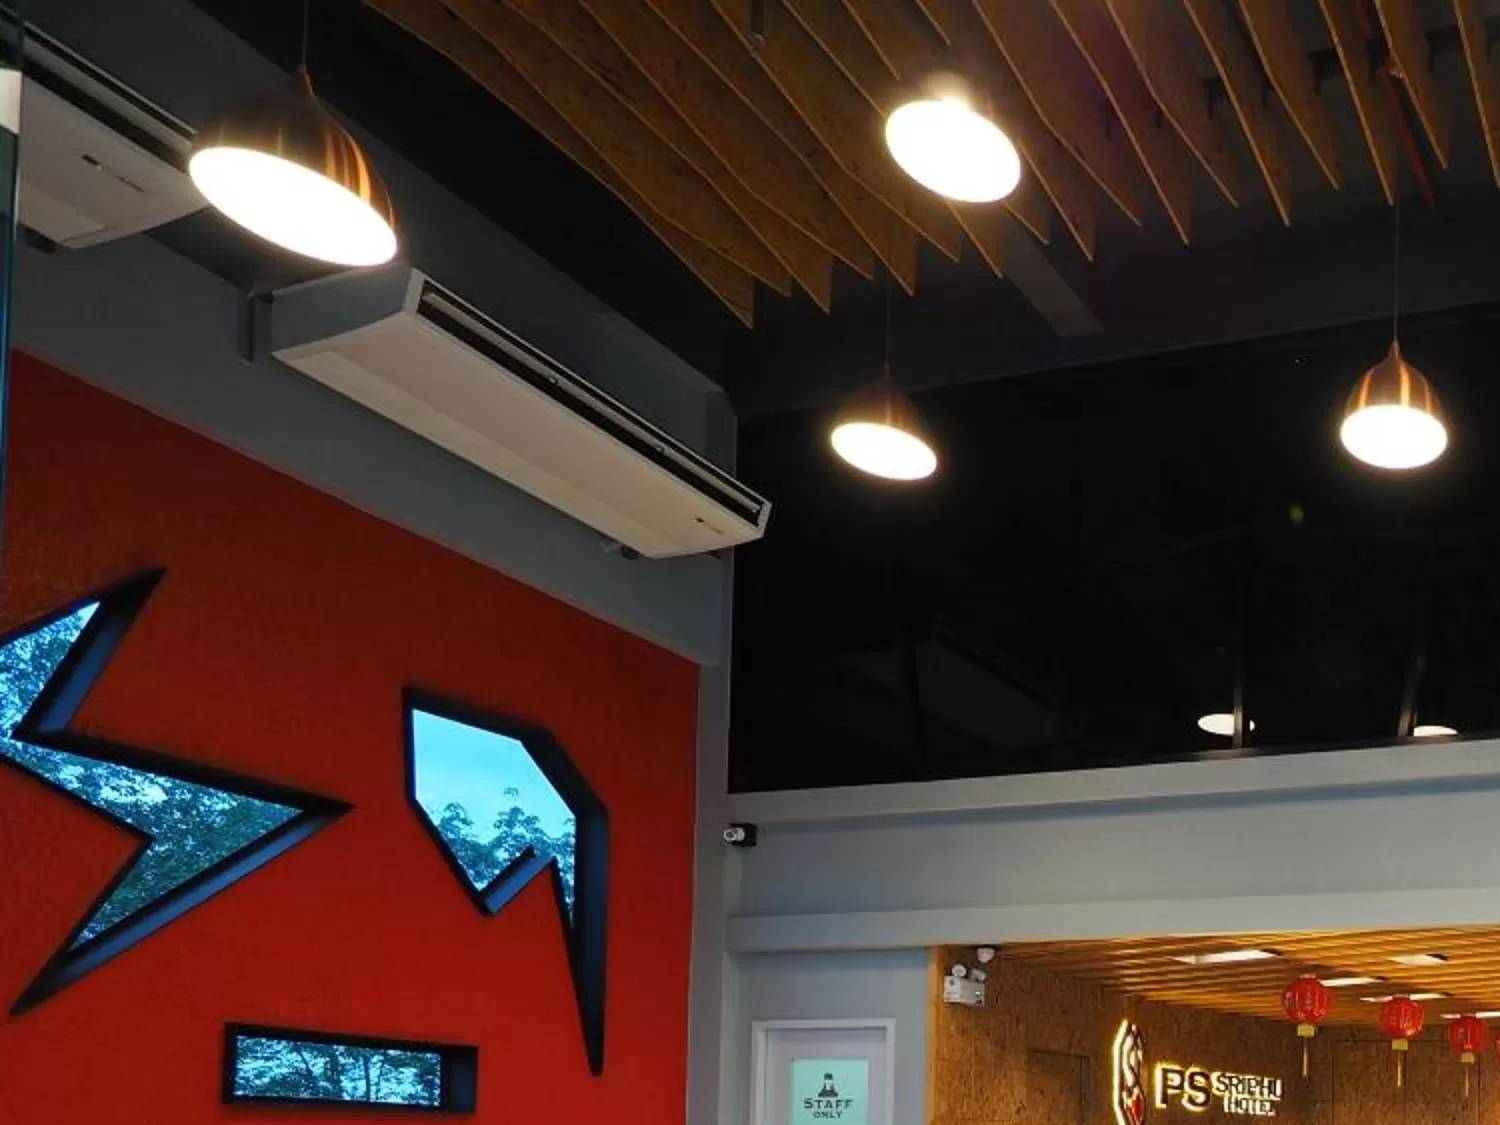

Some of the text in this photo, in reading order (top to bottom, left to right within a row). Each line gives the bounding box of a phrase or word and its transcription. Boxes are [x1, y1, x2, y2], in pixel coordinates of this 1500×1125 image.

[1155, 1063, 1282, 1111] PS SRIPHU
[813, 1110, 842, 1119] ONLY
